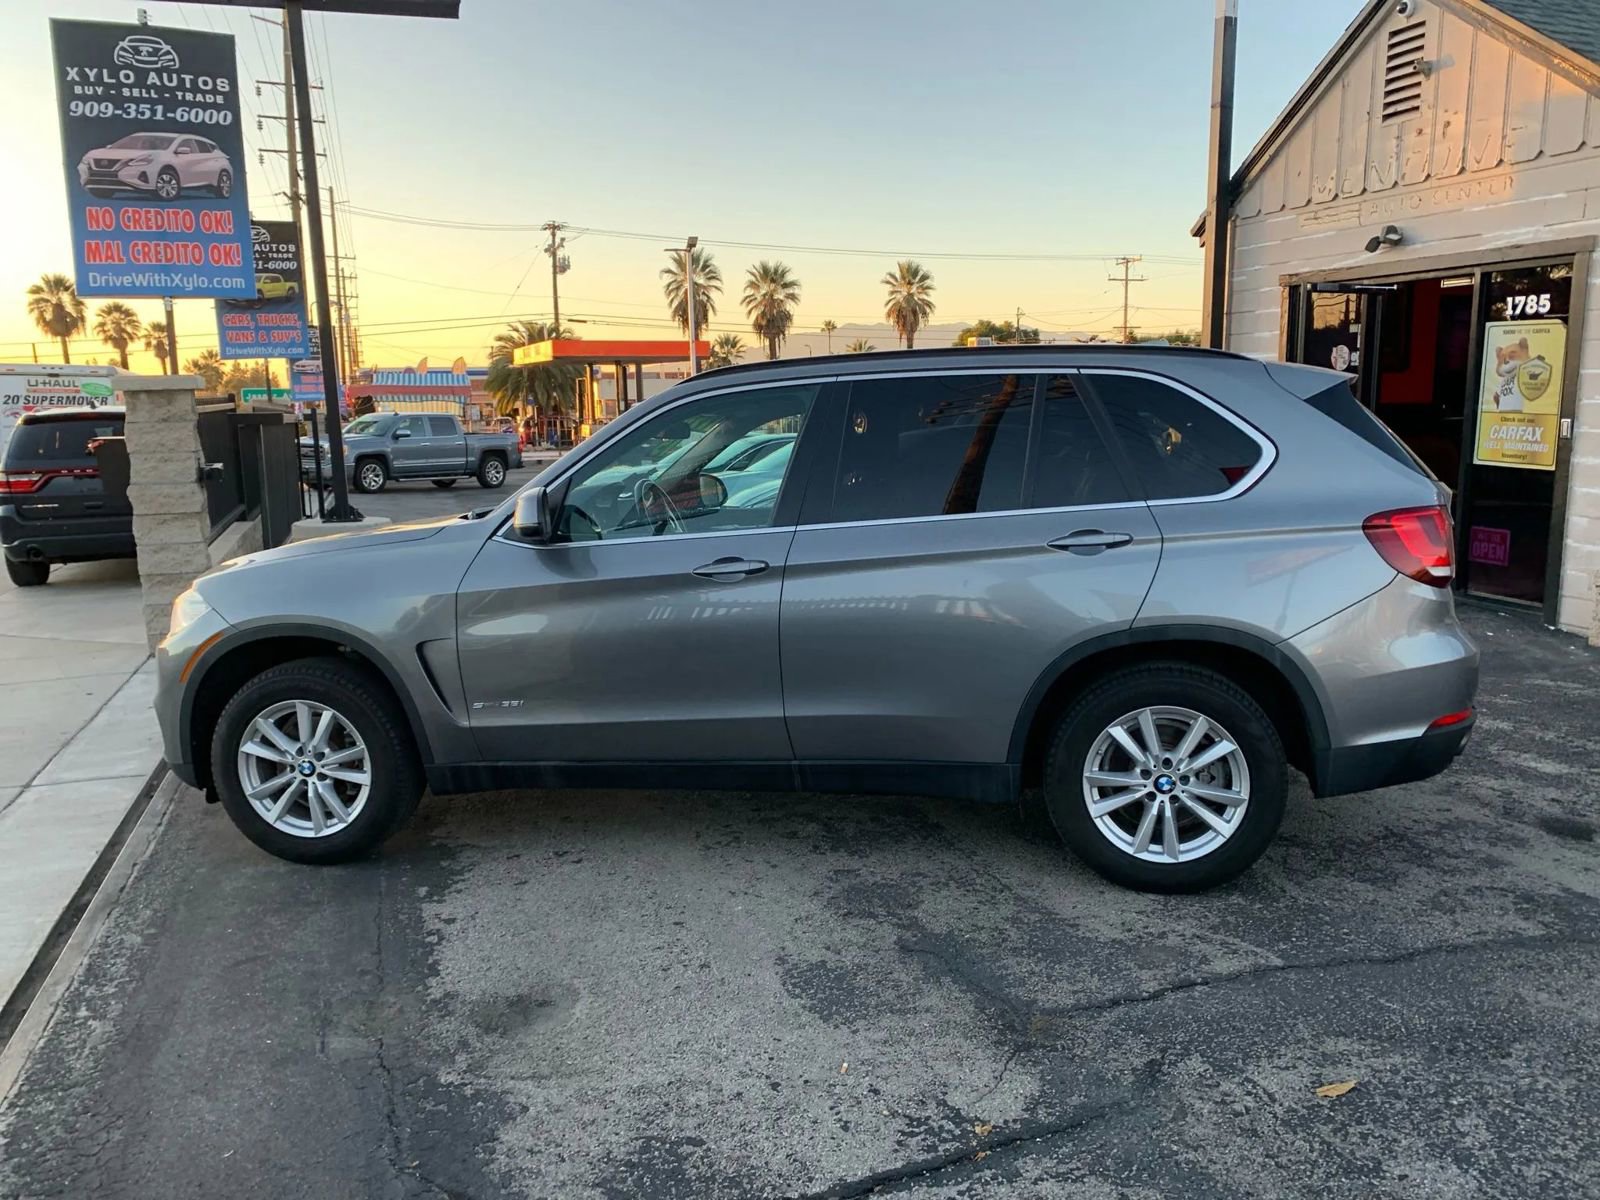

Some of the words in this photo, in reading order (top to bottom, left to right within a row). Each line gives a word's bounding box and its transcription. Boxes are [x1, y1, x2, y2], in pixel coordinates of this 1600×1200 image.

[65, 66, 135, 84] XYLO
[147, 71, 230, 92] AUTOS
[74, 85, 104, 95] BUY
[122, 88, 158, 98] SELL
[176, 91, 224, 104] TRADE
[69, 100, 233, 126] 909-351-6000
[86, 206, 115, 231] NO
[120, 207, 194, 233] CREDITO
[200, 210, 234, 234] OK!
[84, 240, 125, 264] MAL
[130, 240, 203, 266] CREDITO
[208, 243, 242, 266] OK!
[254, 243, 296, 252] AUTOS
[88, 272, 246, 290] DriveWithXylo.com
[1505, 294, 1551, 316] 1785
[226, 330, 255, 344] VANS
[259, 330, 269, 344] &
[270, 330, 302, 344] SUV'S
[1490, 424, 1544, 441] CARFAX
